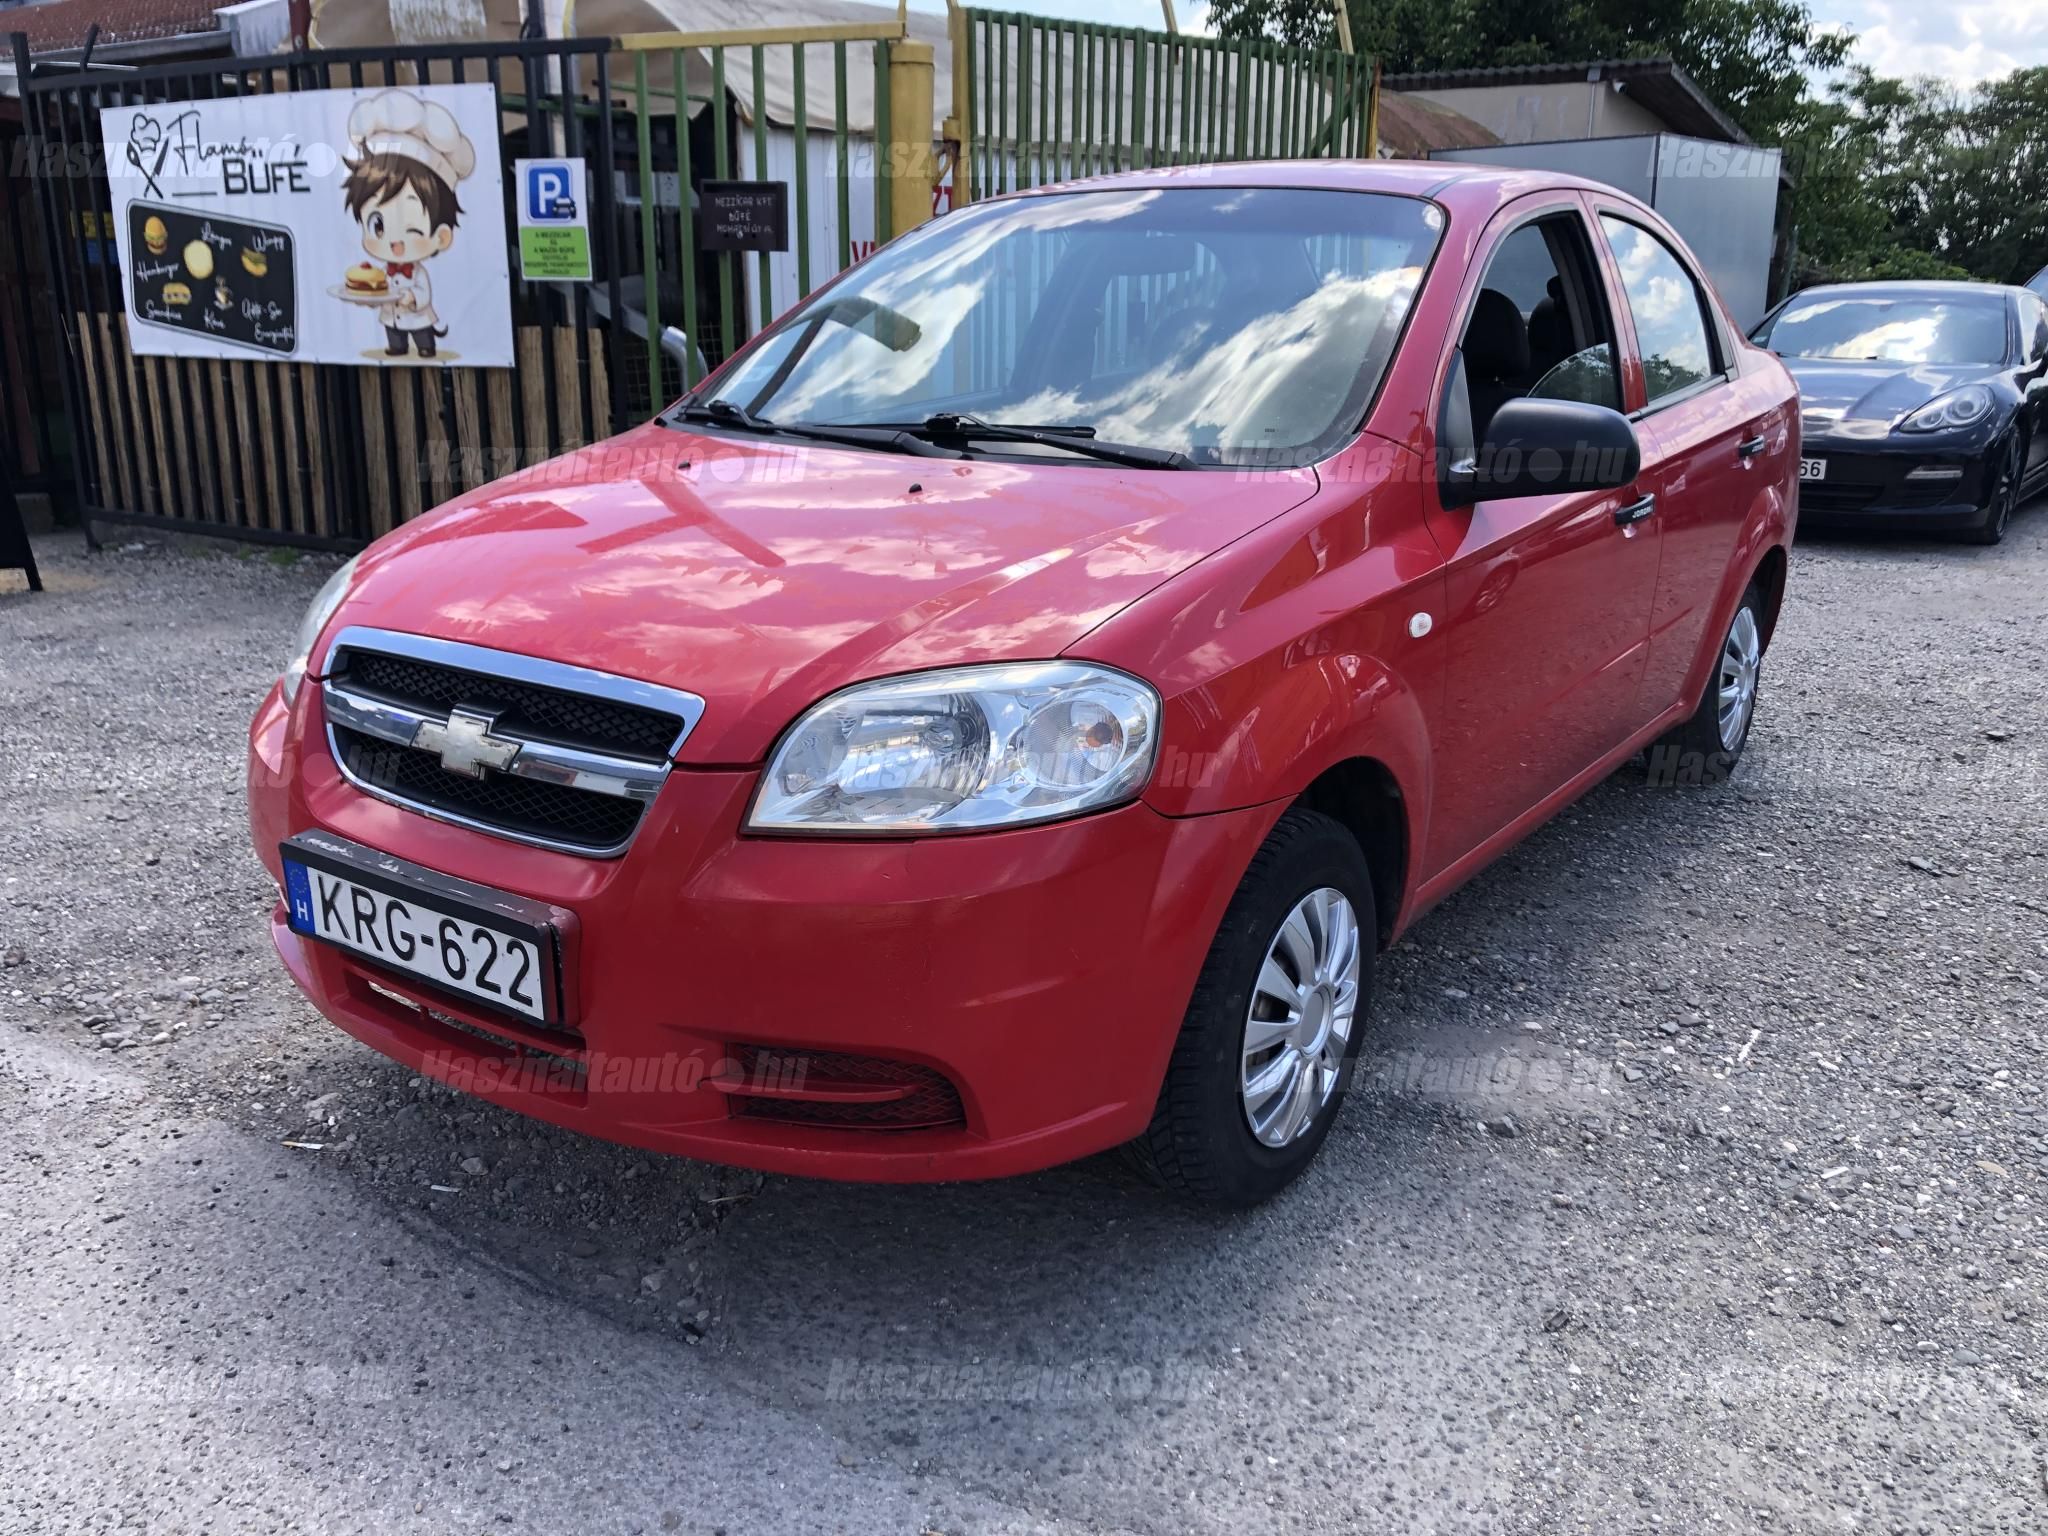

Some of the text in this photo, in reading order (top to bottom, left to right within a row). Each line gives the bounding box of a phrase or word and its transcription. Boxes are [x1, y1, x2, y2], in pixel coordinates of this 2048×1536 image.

[538, 173, 562, 214] P
[296, 898, 309, 922] H
[317, 874, 534, 1008] KRG-622
